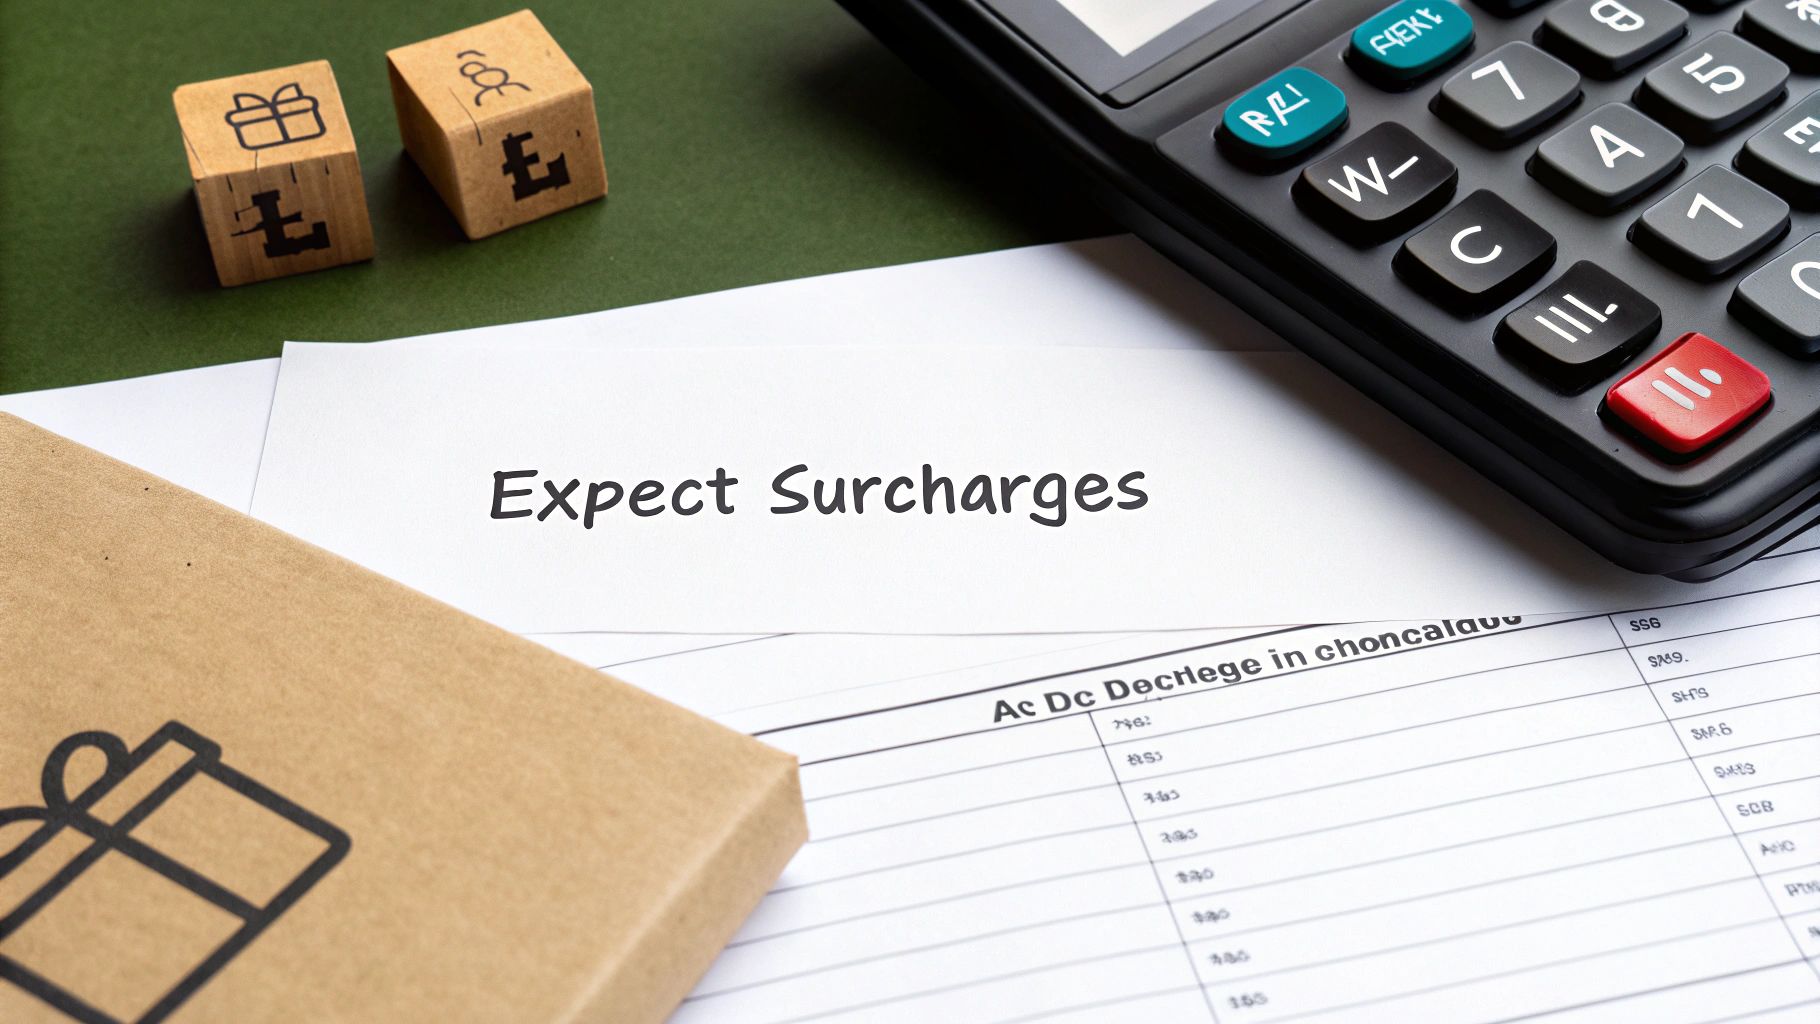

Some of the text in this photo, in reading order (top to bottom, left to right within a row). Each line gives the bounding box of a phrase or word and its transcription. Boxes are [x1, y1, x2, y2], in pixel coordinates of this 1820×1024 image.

[1472, 61, 1525, 100] 7
[1590, 125, 1645, 168] A
[1450, 225, 1502, 264] C
[490, 464, 1149, 529] Expect Surcharges
[994, 699, 1037, 723] Ac
[1043, 690, 1096, 713] Dc
[1268, 648, 1308, 671] in
